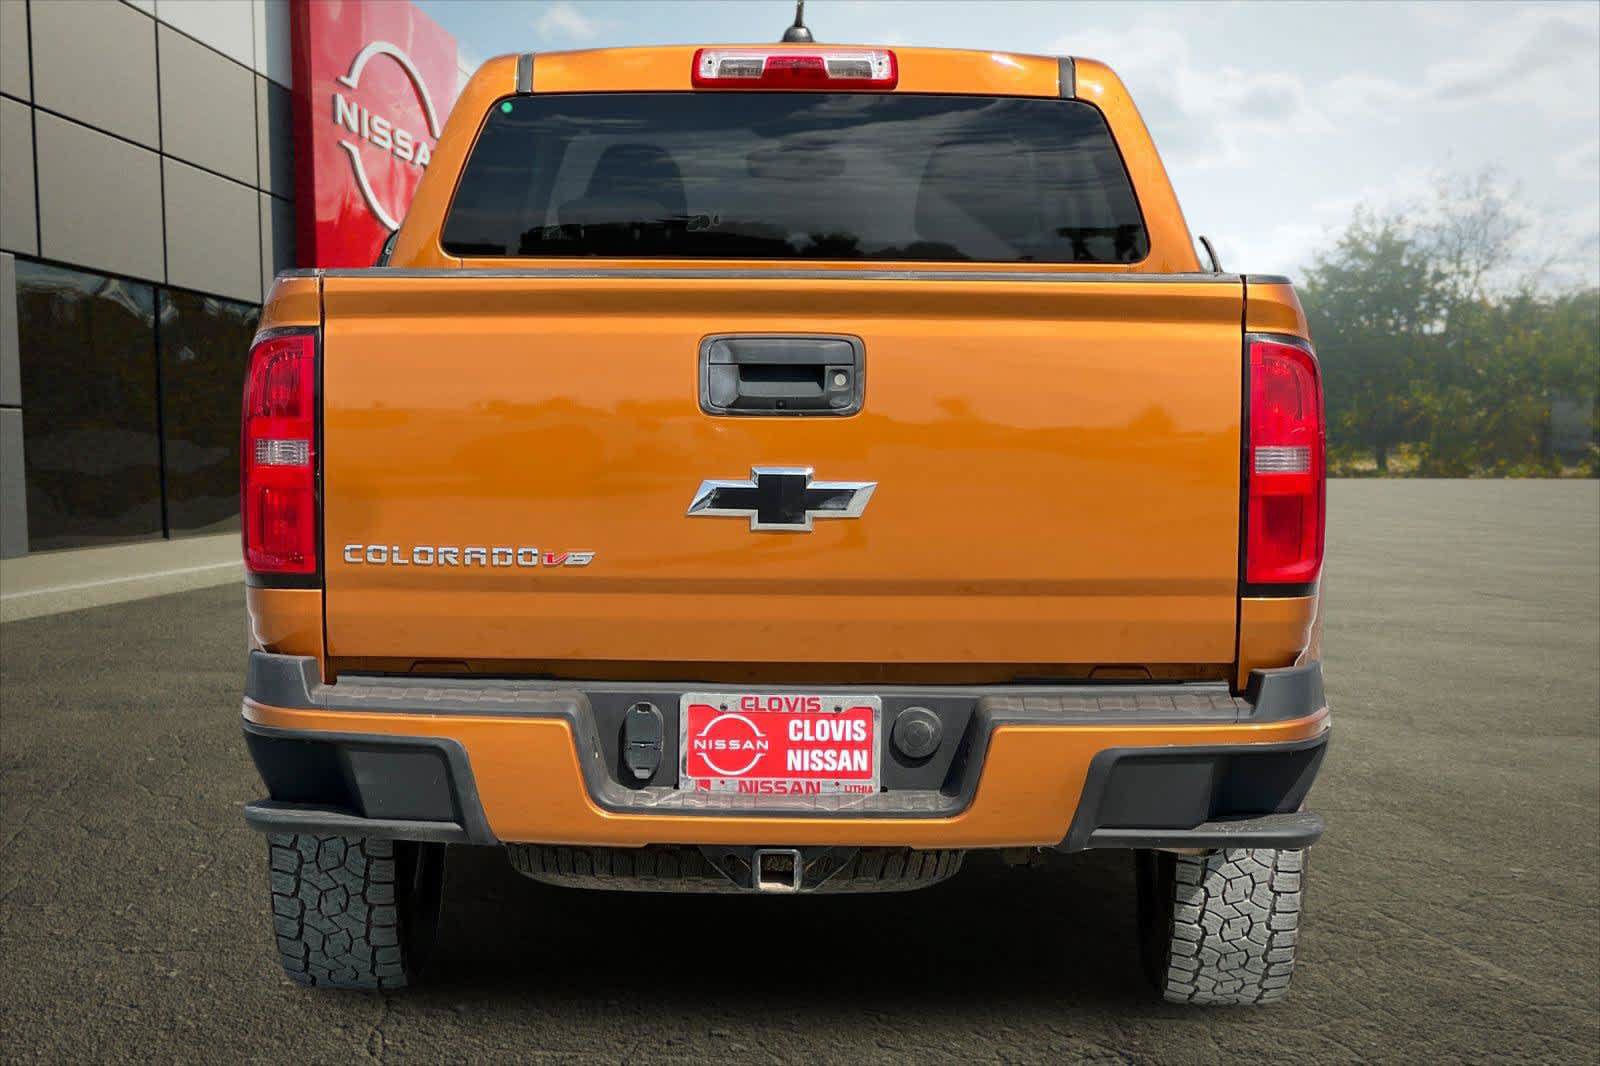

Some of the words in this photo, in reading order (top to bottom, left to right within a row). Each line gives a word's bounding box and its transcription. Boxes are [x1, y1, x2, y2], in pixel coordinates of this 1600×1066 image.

[344, 544, 538, 566] COLORADO
[542, 551, 596, 565] V6
[740, 696, 822, 713] CLOVIS
[788, 718, 867, 743] CLOVIS
[693, 738, 769, 751] NISSAN
[786, 748, 869, 772] NISSAN
[738, 780, 821, 795] NISSAN
[843, 784, 874, 794] LITHIA
